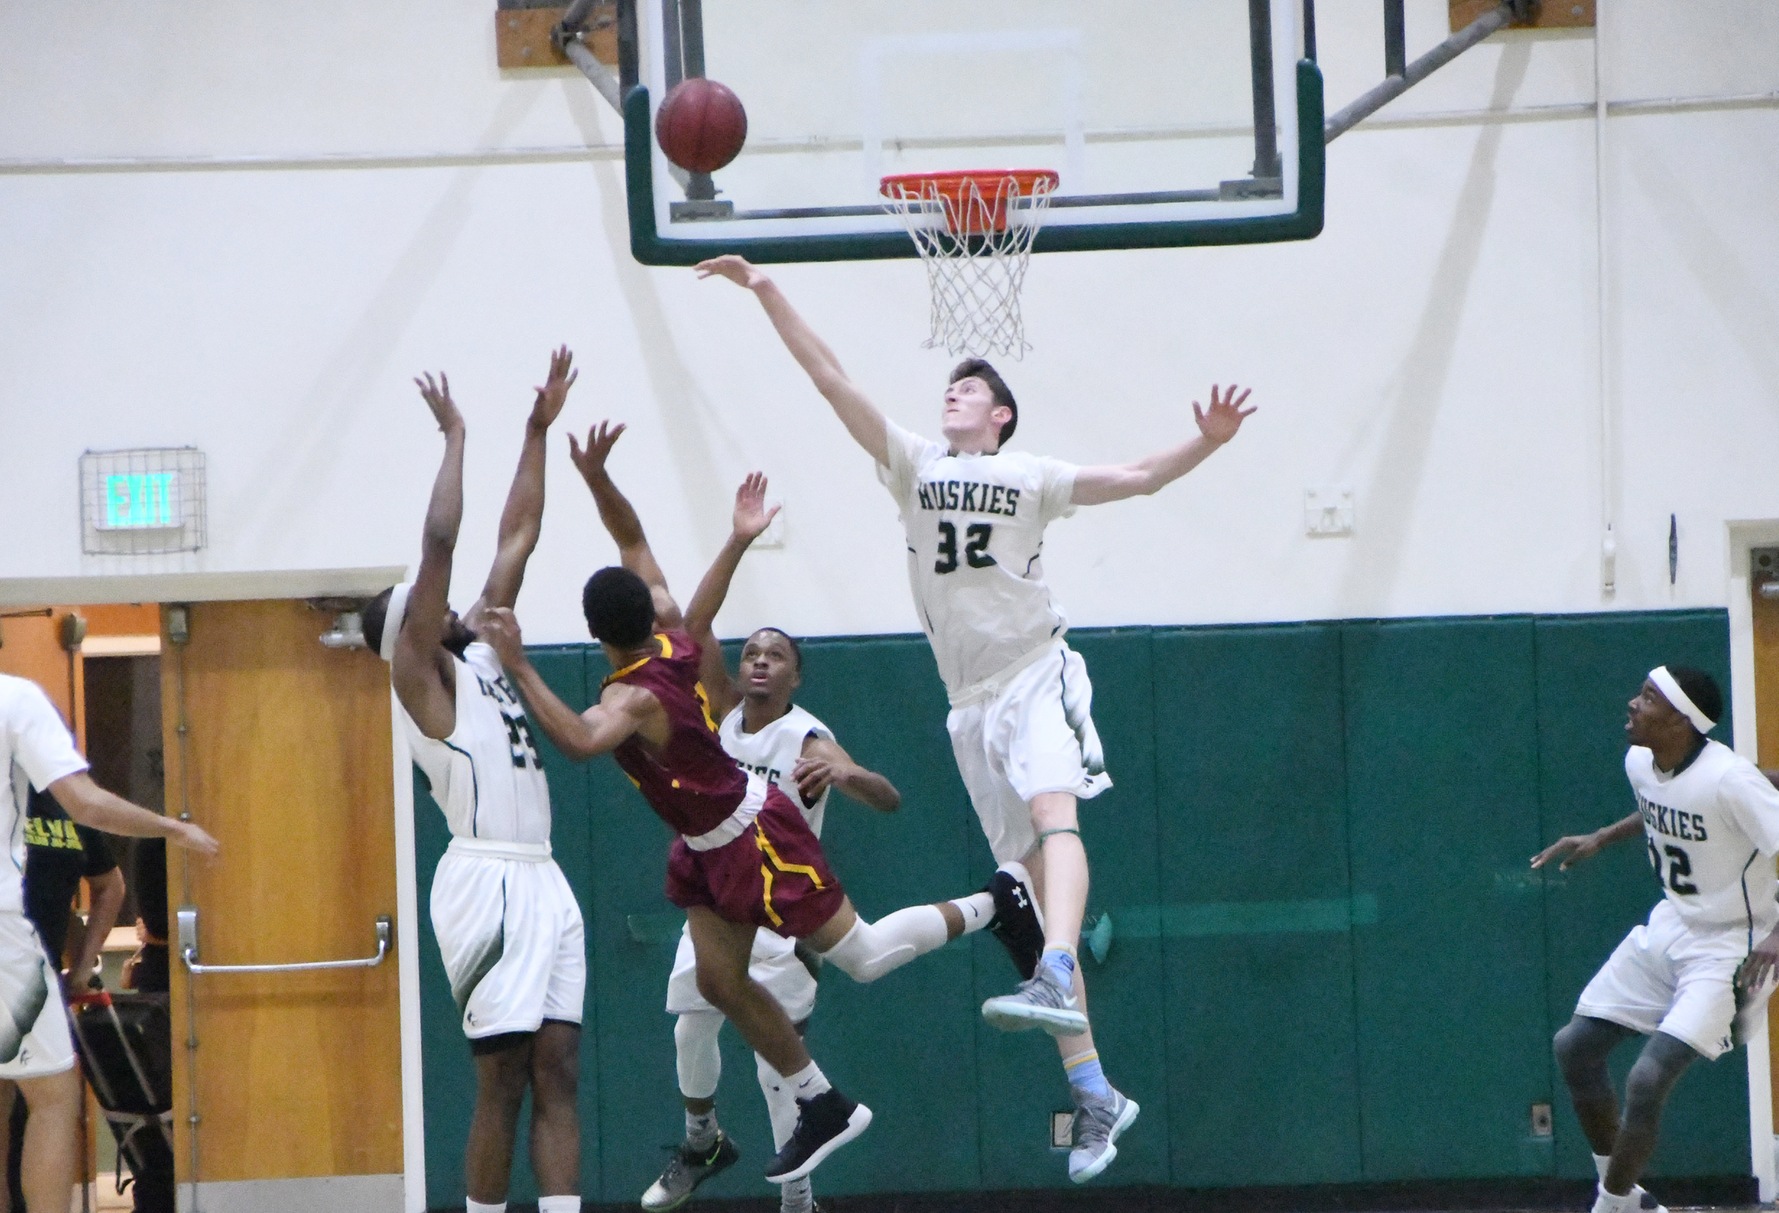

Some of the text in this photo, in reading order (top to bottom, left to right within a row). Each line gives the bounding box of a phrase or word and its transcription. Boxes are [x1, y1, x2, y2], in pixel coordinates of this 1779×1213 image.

[106, 473, 173, 526] EXIT
[918, 480, 1020, 517] HUSKIES
[934, 520, 998, 574] 32
